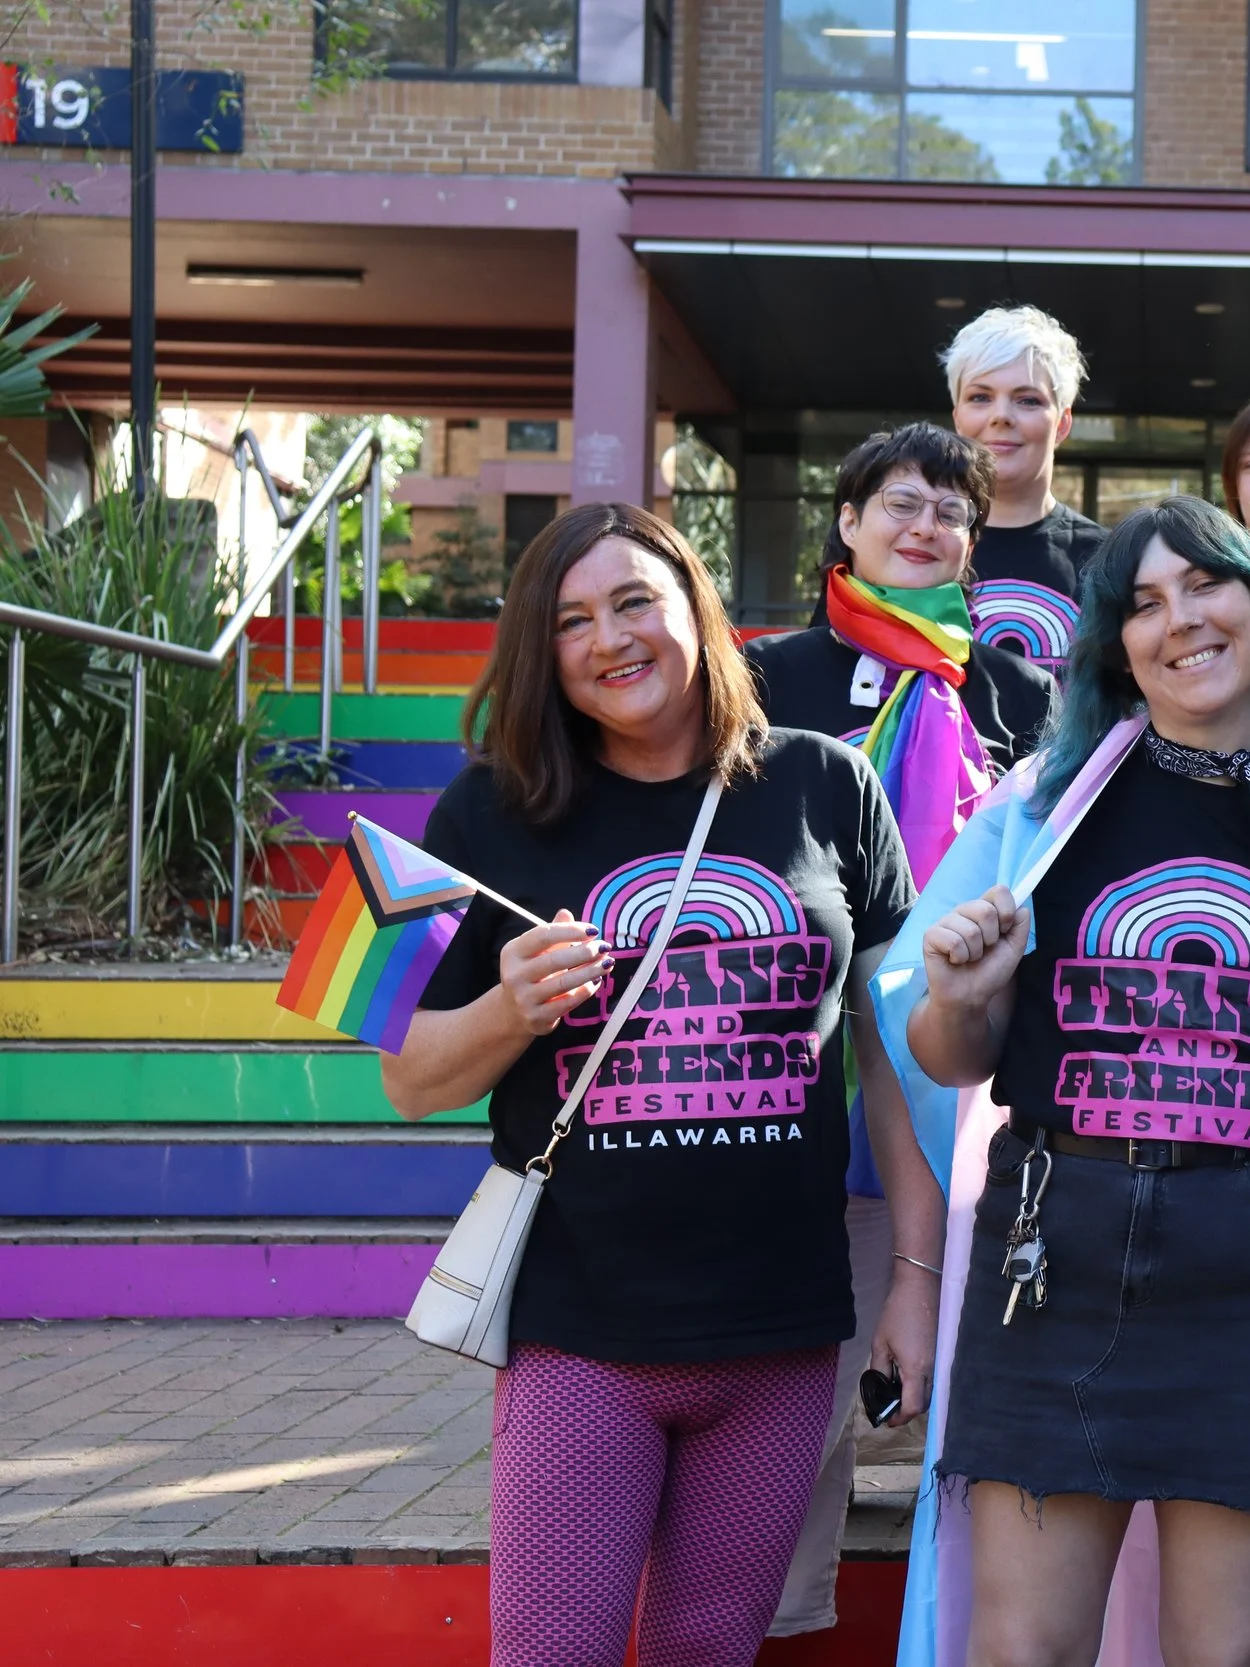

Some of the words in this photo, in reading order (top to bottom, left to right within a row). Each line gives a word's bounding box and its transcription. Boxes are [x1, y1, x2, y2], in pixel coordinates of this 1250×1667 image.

[26, 78, 90, 130] 19
[652, 1015, 737, 1037] AND
[1146, 1037, 1231, 1059] AND
[562, 1038, 818, 1094] FRIENDS
[589, 1088, 802, 1118] FESTIVAL
[588, 1123, 803, 1151] ILLAWARRA
